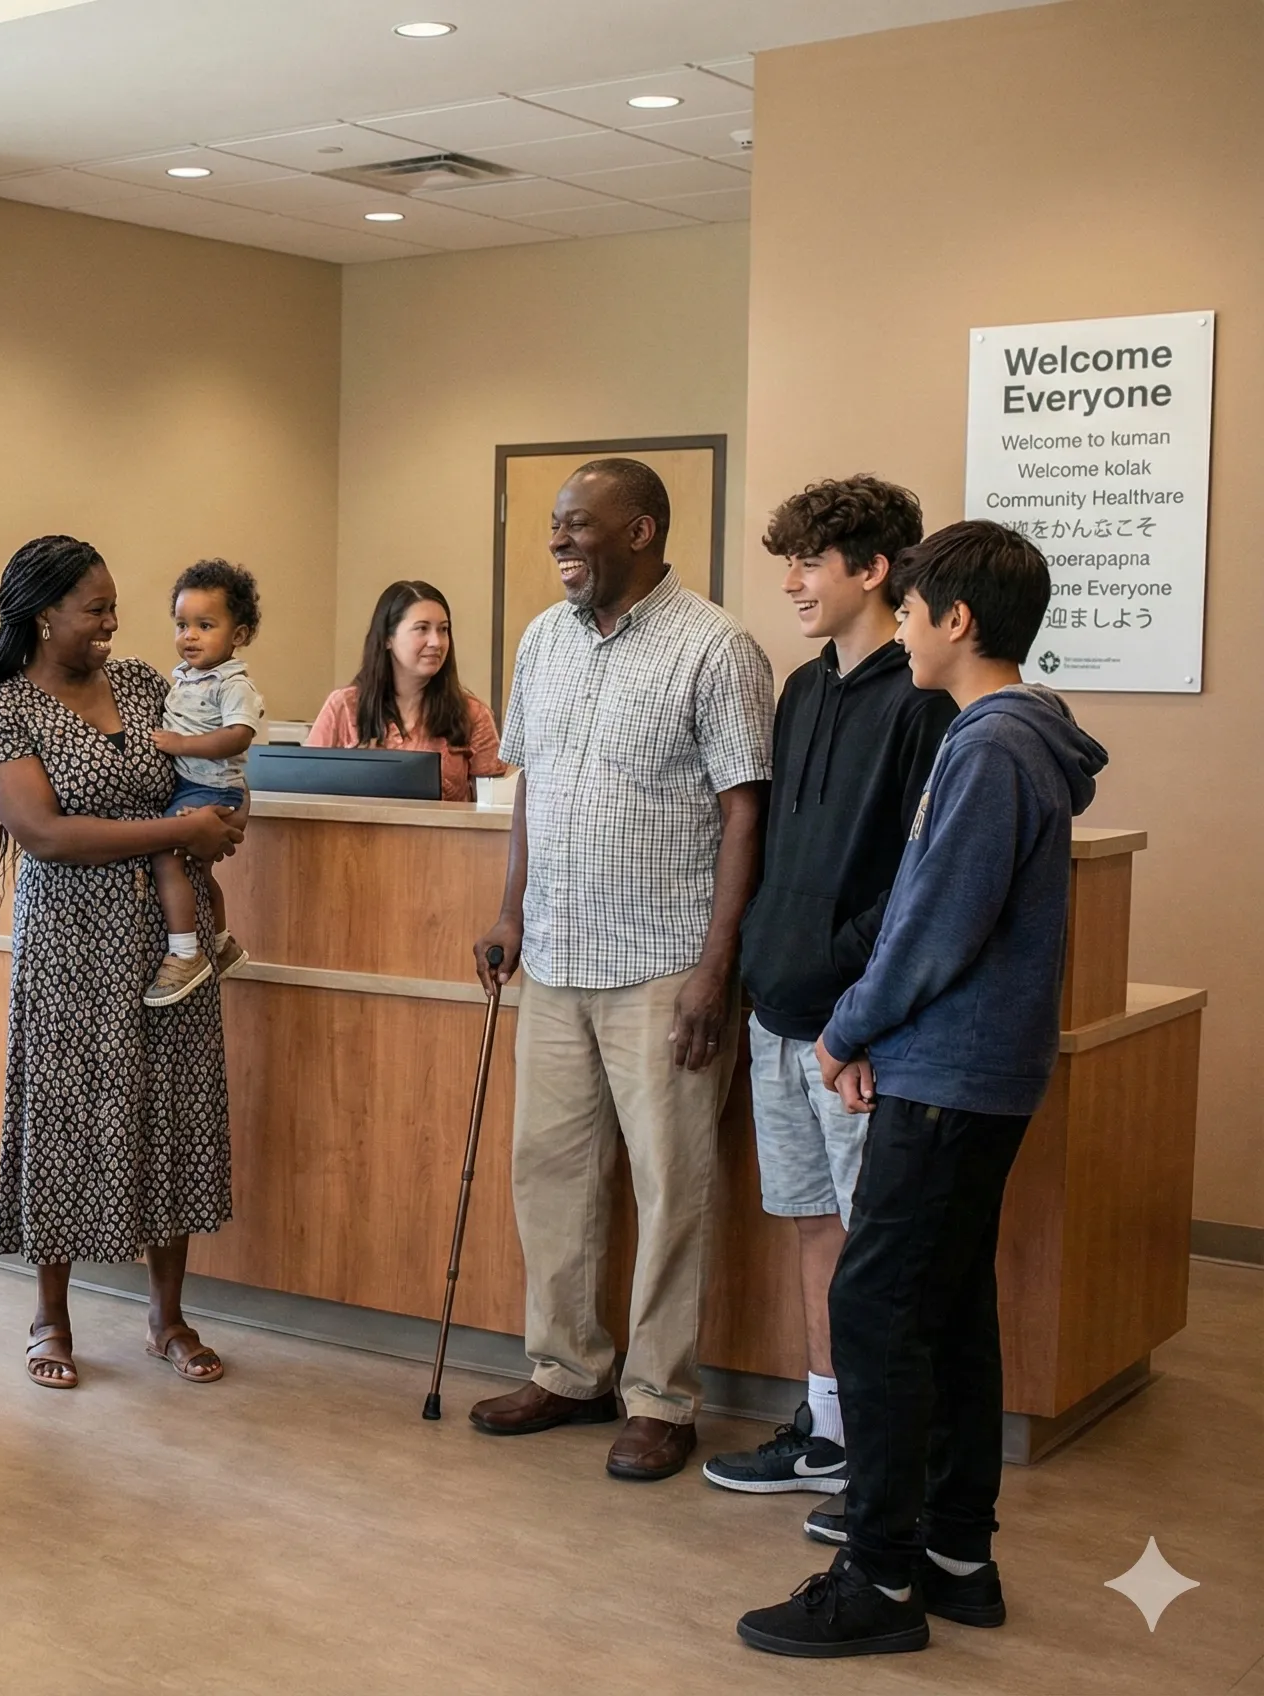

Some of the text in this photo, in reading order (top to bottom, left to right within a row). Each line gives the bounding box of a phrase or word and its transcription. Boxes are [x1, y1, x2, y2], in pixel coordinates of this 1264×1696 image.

[1004, 345, 1173, 377] Welcome
[1003, 383, 1173, 417] Everyone
[1001, 430, 1171, 451] Welcome to kuman
[1018, 459, 1152, 479] Welcome kolak
[986, 491, 1087, 511] Community
[1087, 580, 1173, 600] Everyone
